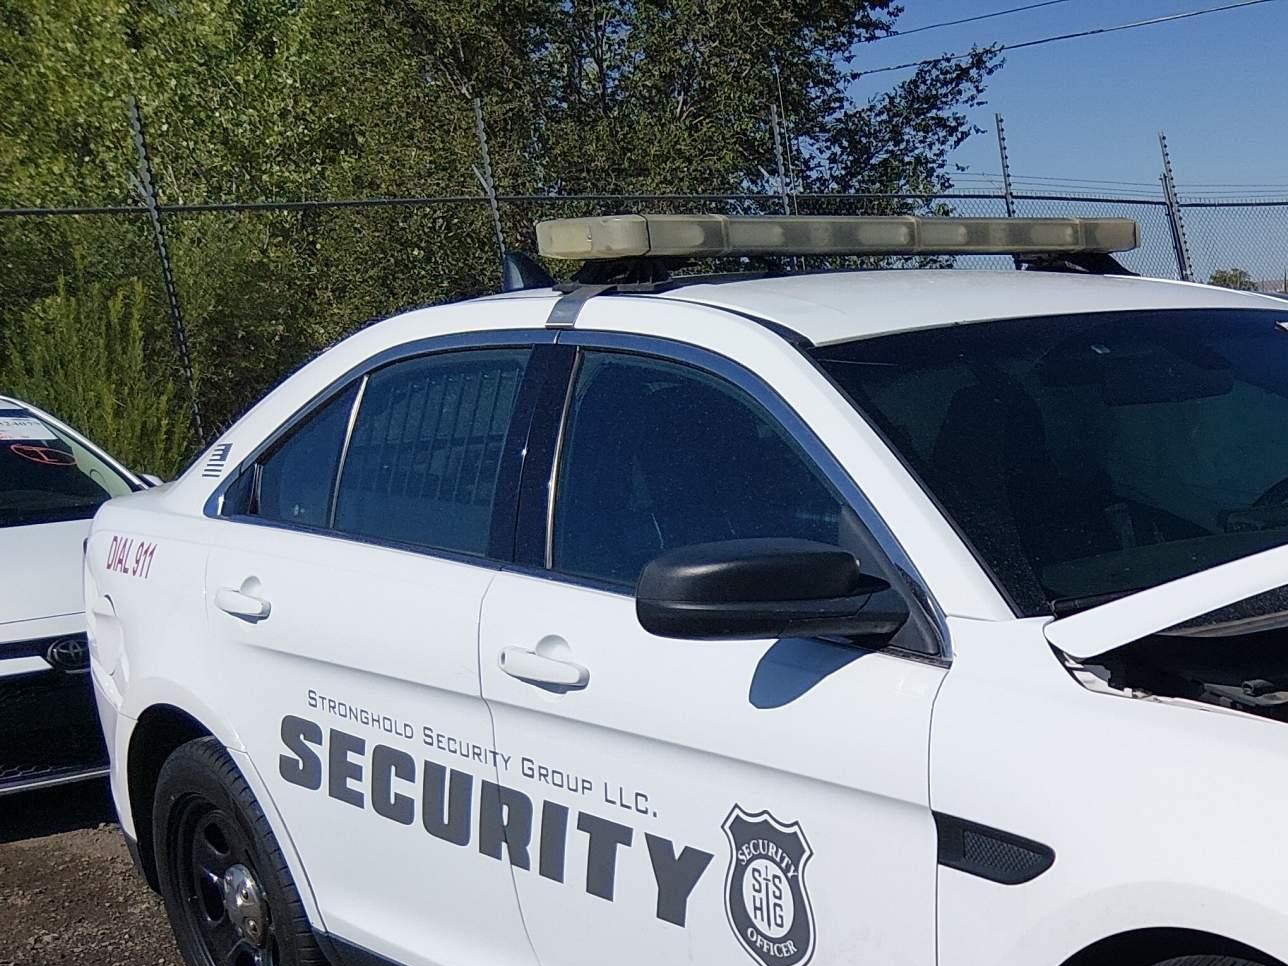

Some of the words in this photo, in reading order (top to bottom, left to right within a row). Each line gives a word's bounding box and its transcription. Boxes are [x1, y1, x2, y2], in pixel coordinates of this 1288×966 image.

[106, 535, 134, 574] DIAL
[132, 541, 158, 579] 911
[308, 689, 414, 739] STRONGHOLD
[423, 726, 511, 770] SECURITY
[521, 757, 593, 795] GROUP
[604, 782, 657, 818] LLC.
[279, 714, 715, 928] SECURITY
[737, 839, 798, 879] SECURITY
[747, 927, 797, 958] OFFICER
